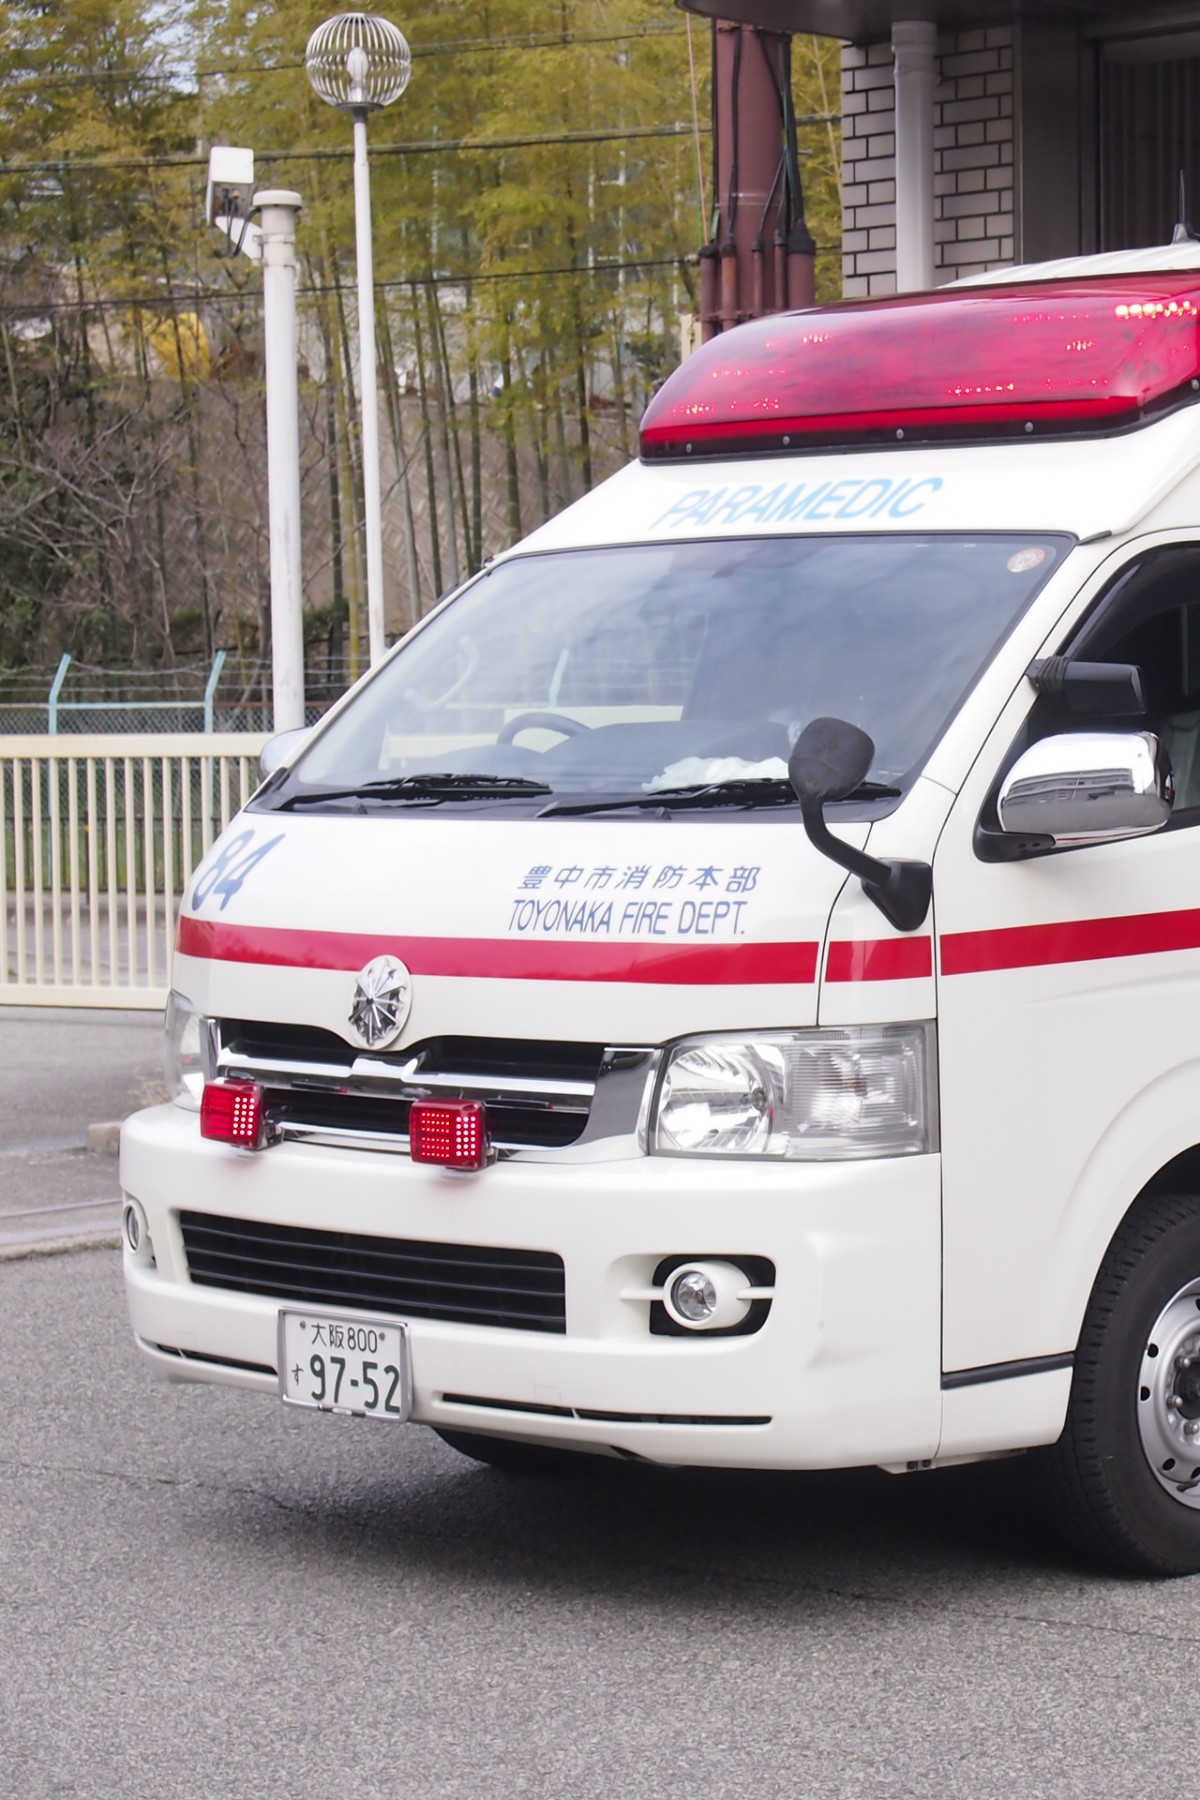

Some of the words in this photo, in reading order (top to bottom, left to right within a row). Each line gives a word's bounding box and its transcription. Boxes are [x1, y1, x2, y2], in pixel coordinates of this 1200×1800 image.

[648, 477, 943, 530] PARAMEDIC
[191, 829, 286, 911] 84
[517, 865, 761, 894] 豊中市消防本部
[508, 899, 614, 934] TOYONAKA
[619, 901, 671, 935] FIRE
[677, 901, 746, 935] DEPT.
[291, 1363, 304, 1386] す
[310, 1354, 401, 1413] 97-52
